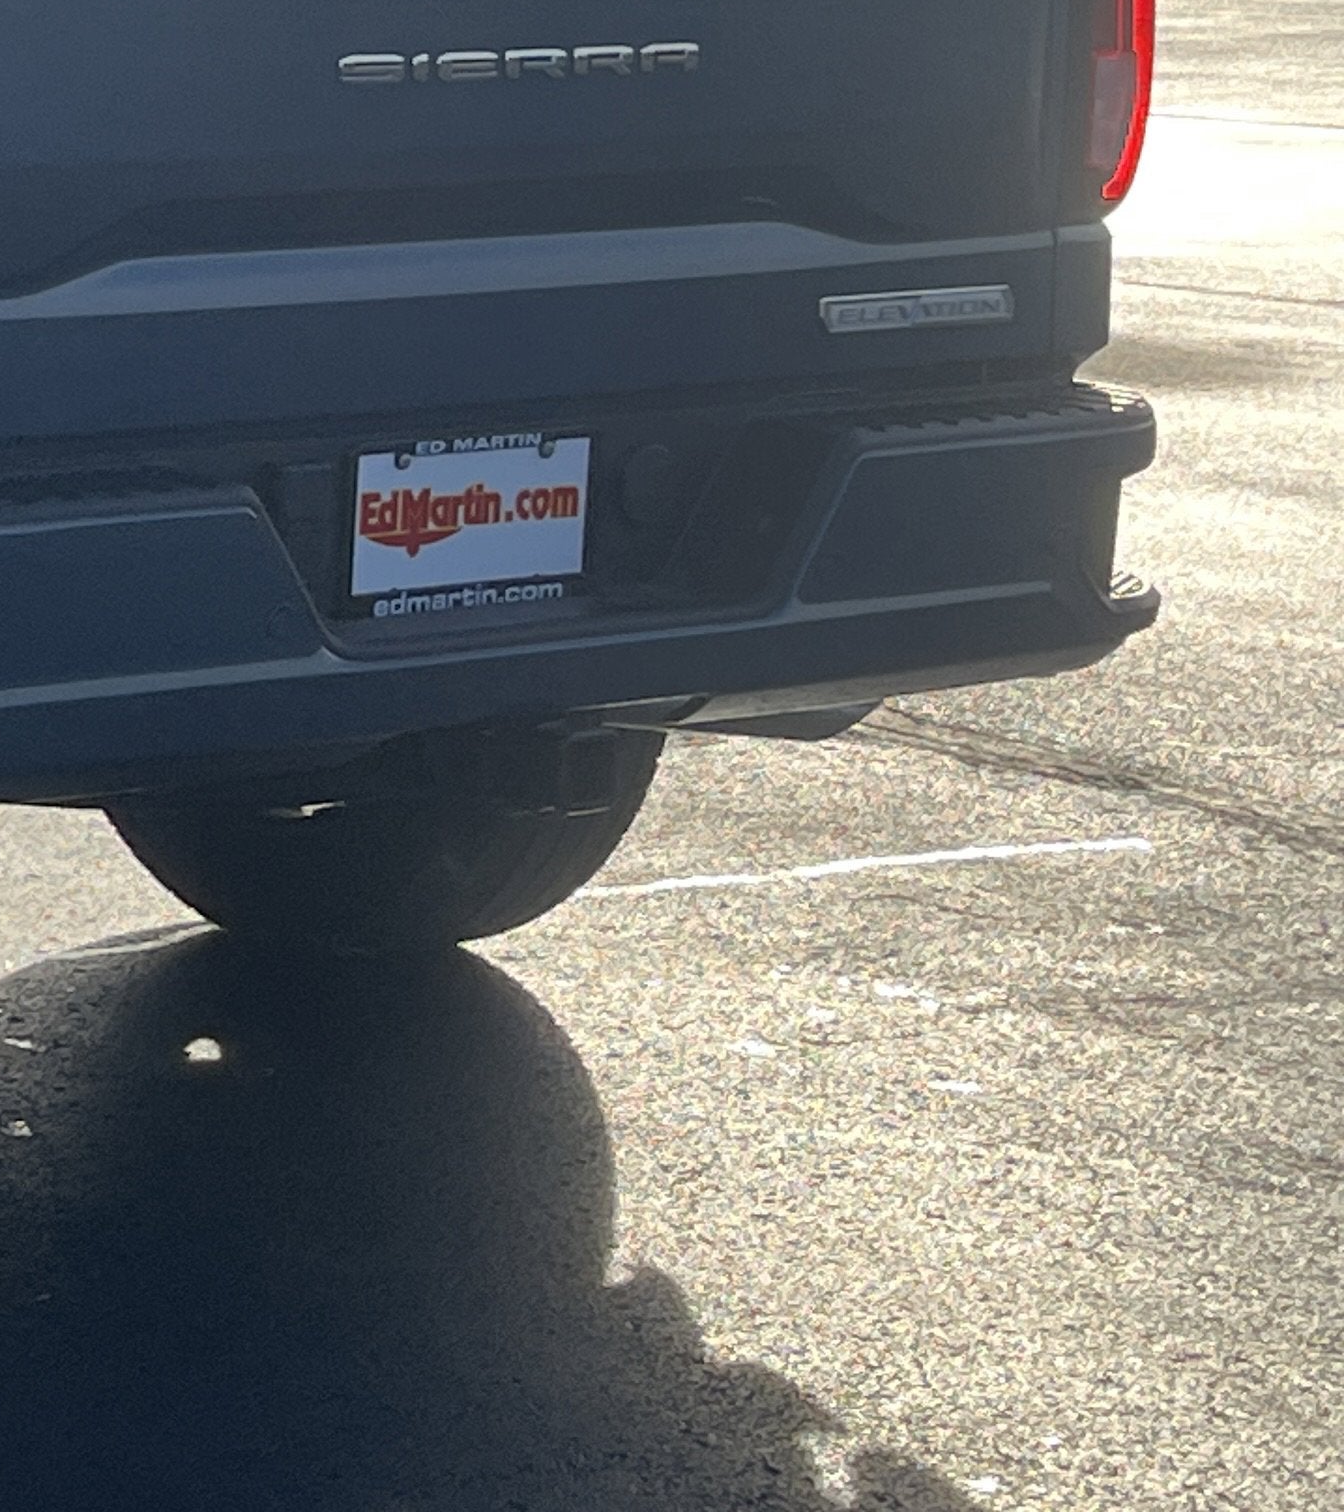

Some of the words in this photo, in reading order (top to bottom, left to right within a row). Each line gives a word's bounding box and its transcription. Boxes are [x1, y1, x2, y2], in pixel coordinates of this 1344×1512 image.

[338, 42, 700, 84] SIERRA
[837, 299, 1002, 325] ELEVATION
[416, 441, 446, 456] ED
[452, 433, 542, 451] MARTIN
[359, 484, 579, 536] EdMartin.com
[373, 582, 563, 617] edmartin.com
